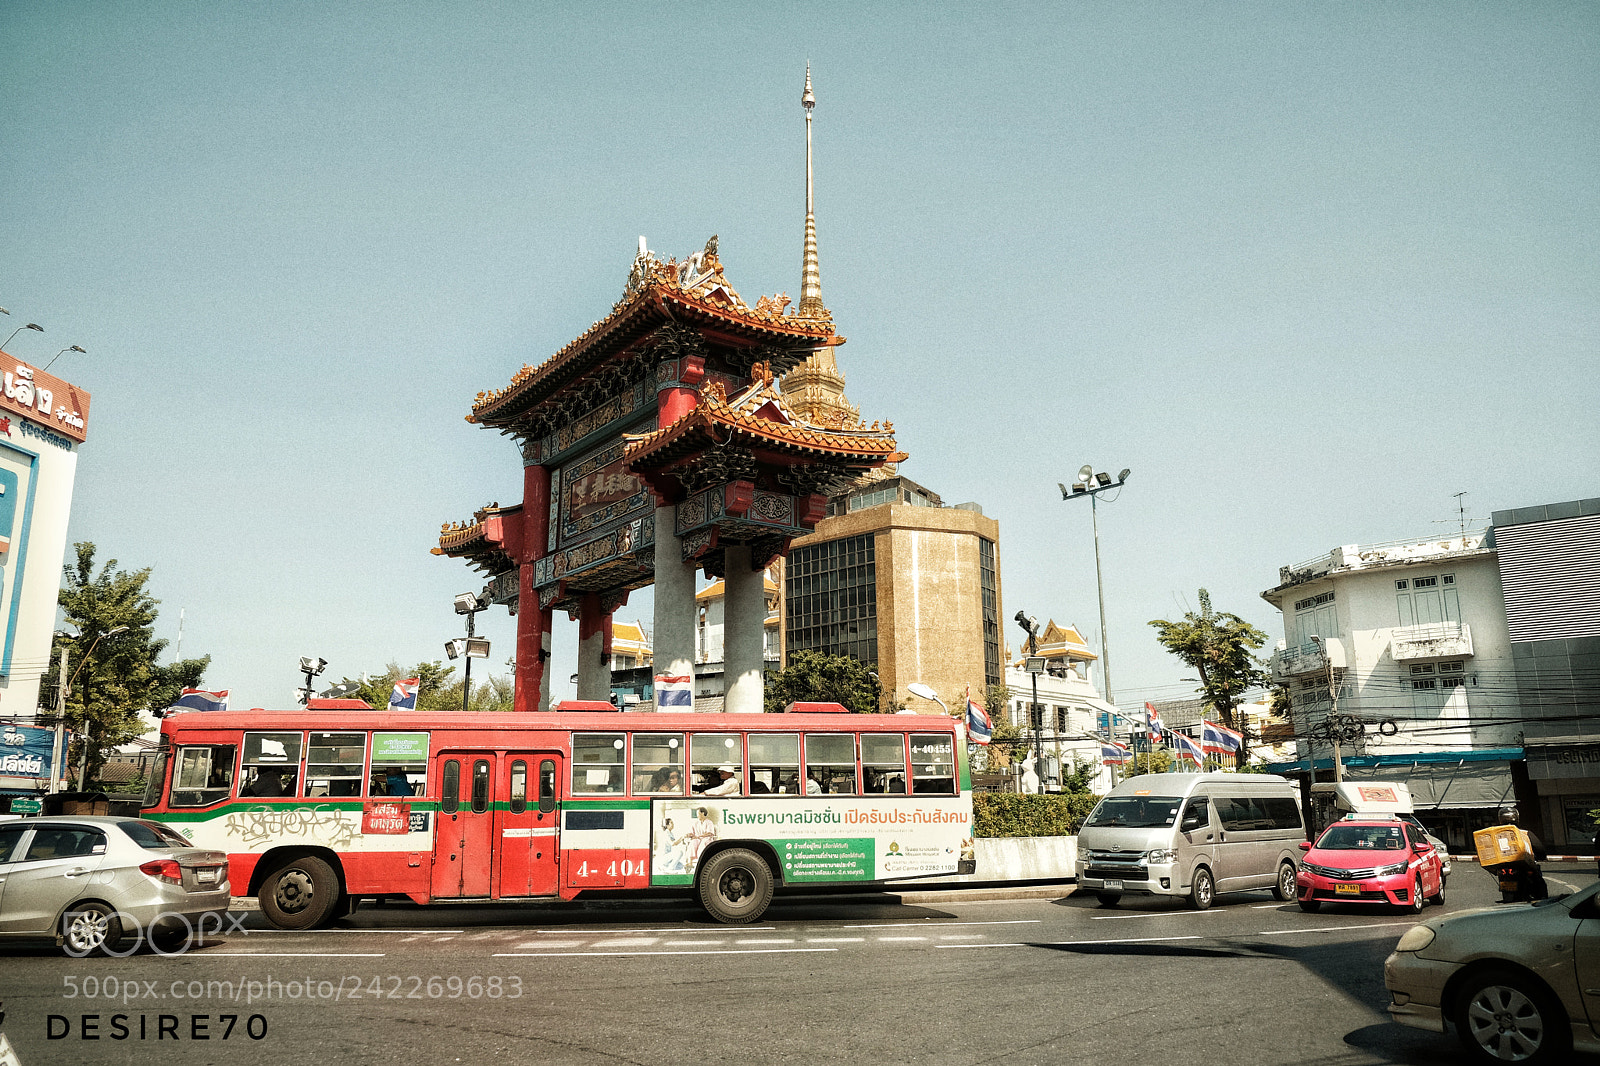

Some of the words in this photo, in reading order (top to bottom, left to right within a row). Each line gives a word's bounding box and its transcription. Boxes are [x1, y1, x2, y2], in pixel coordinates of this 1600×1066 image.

[911, 744, 951, 754] 4-40455
[722, 806, 841, 825] โรงพยาบาลมิชชั่น
[844, 808, 968, 824] เปิดรับประกันสังคม
